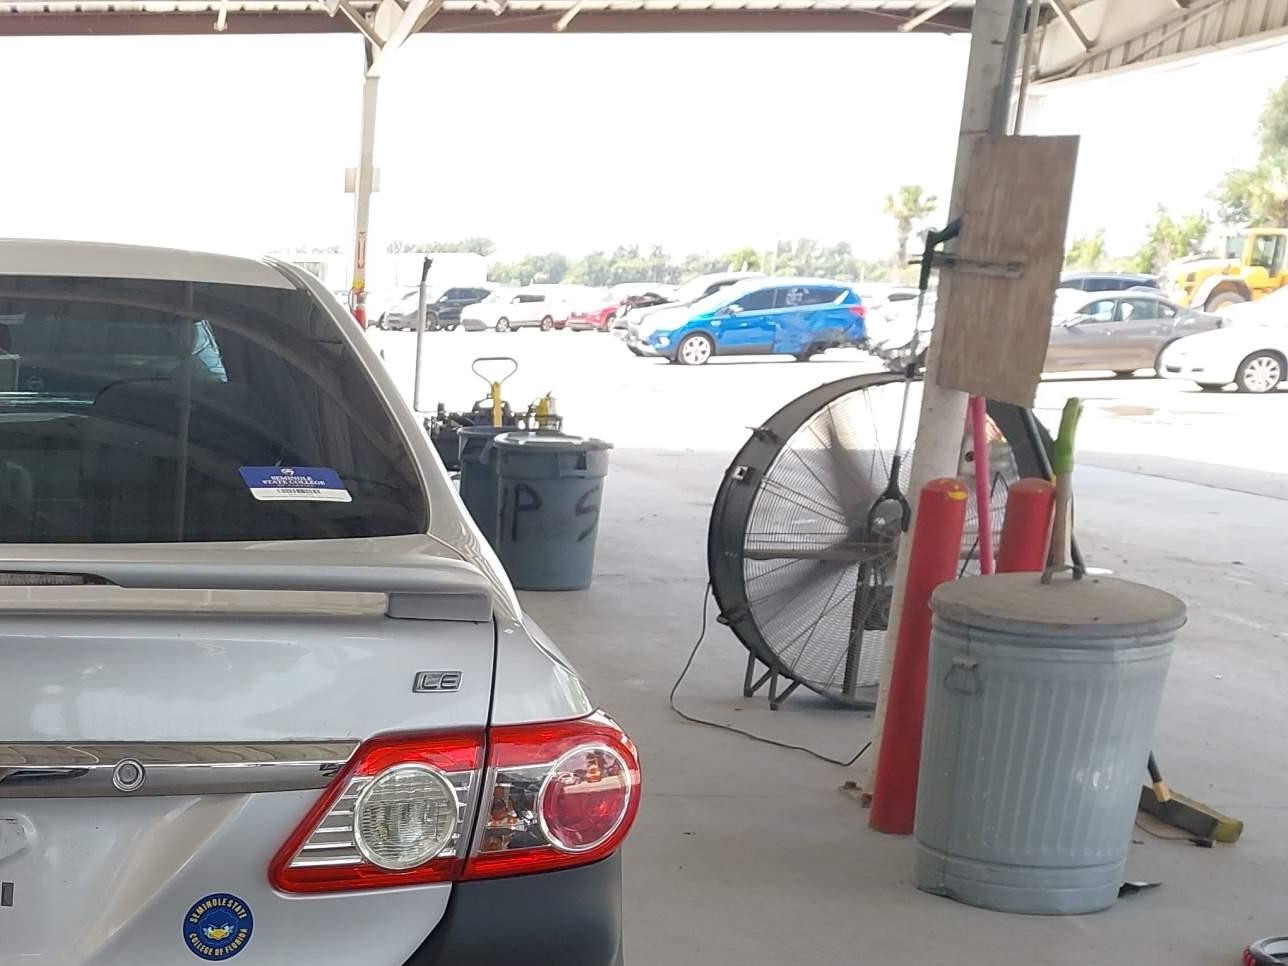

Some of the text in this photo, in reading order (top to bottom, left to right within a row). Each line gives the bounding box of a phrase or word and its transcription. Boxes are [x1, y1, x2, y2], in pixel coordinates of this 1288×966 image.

[416, 672, 461, 690] LE
[189, 928, 248, 956] COLLEGE OF FLORIDA
